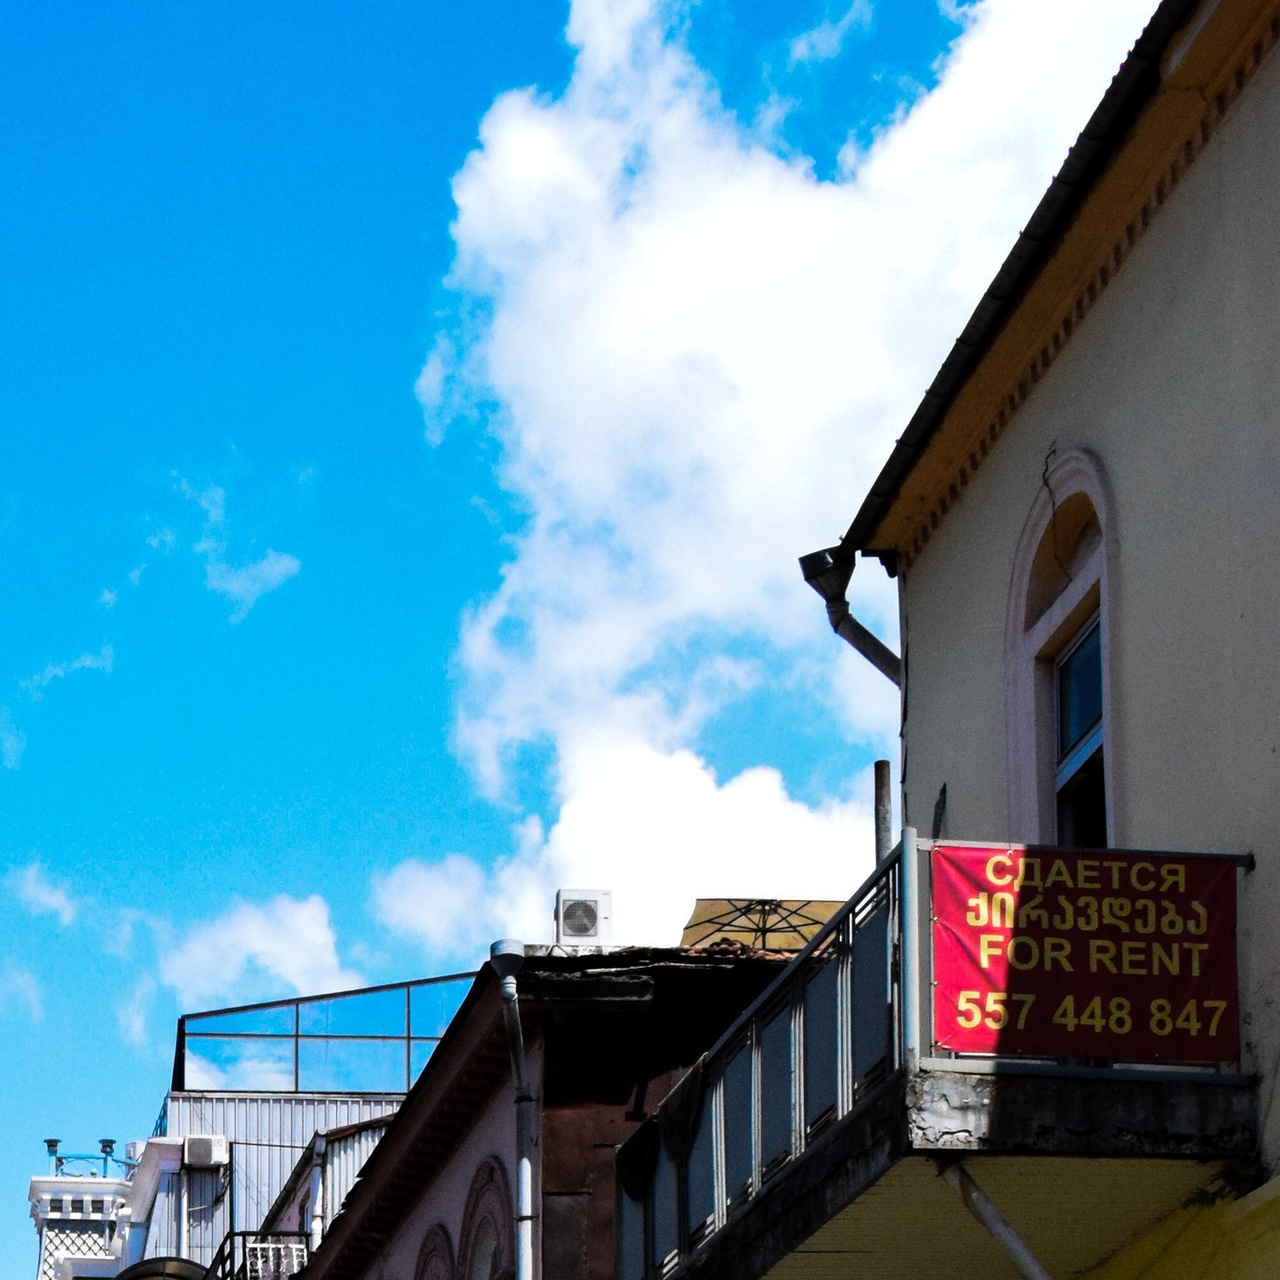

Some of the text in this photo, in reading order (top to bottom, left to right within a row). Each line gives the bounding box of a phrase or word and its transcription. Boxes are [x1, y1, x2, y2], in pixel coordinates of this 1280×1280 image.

[985, 855, 1187, 893] СДАЕТСЯ
[967, 893, 1208, 935] ქირავდება
[979, 934, 1209, 977] FOR RENT
[956, 990, 1228, 1037] 557 448 847
